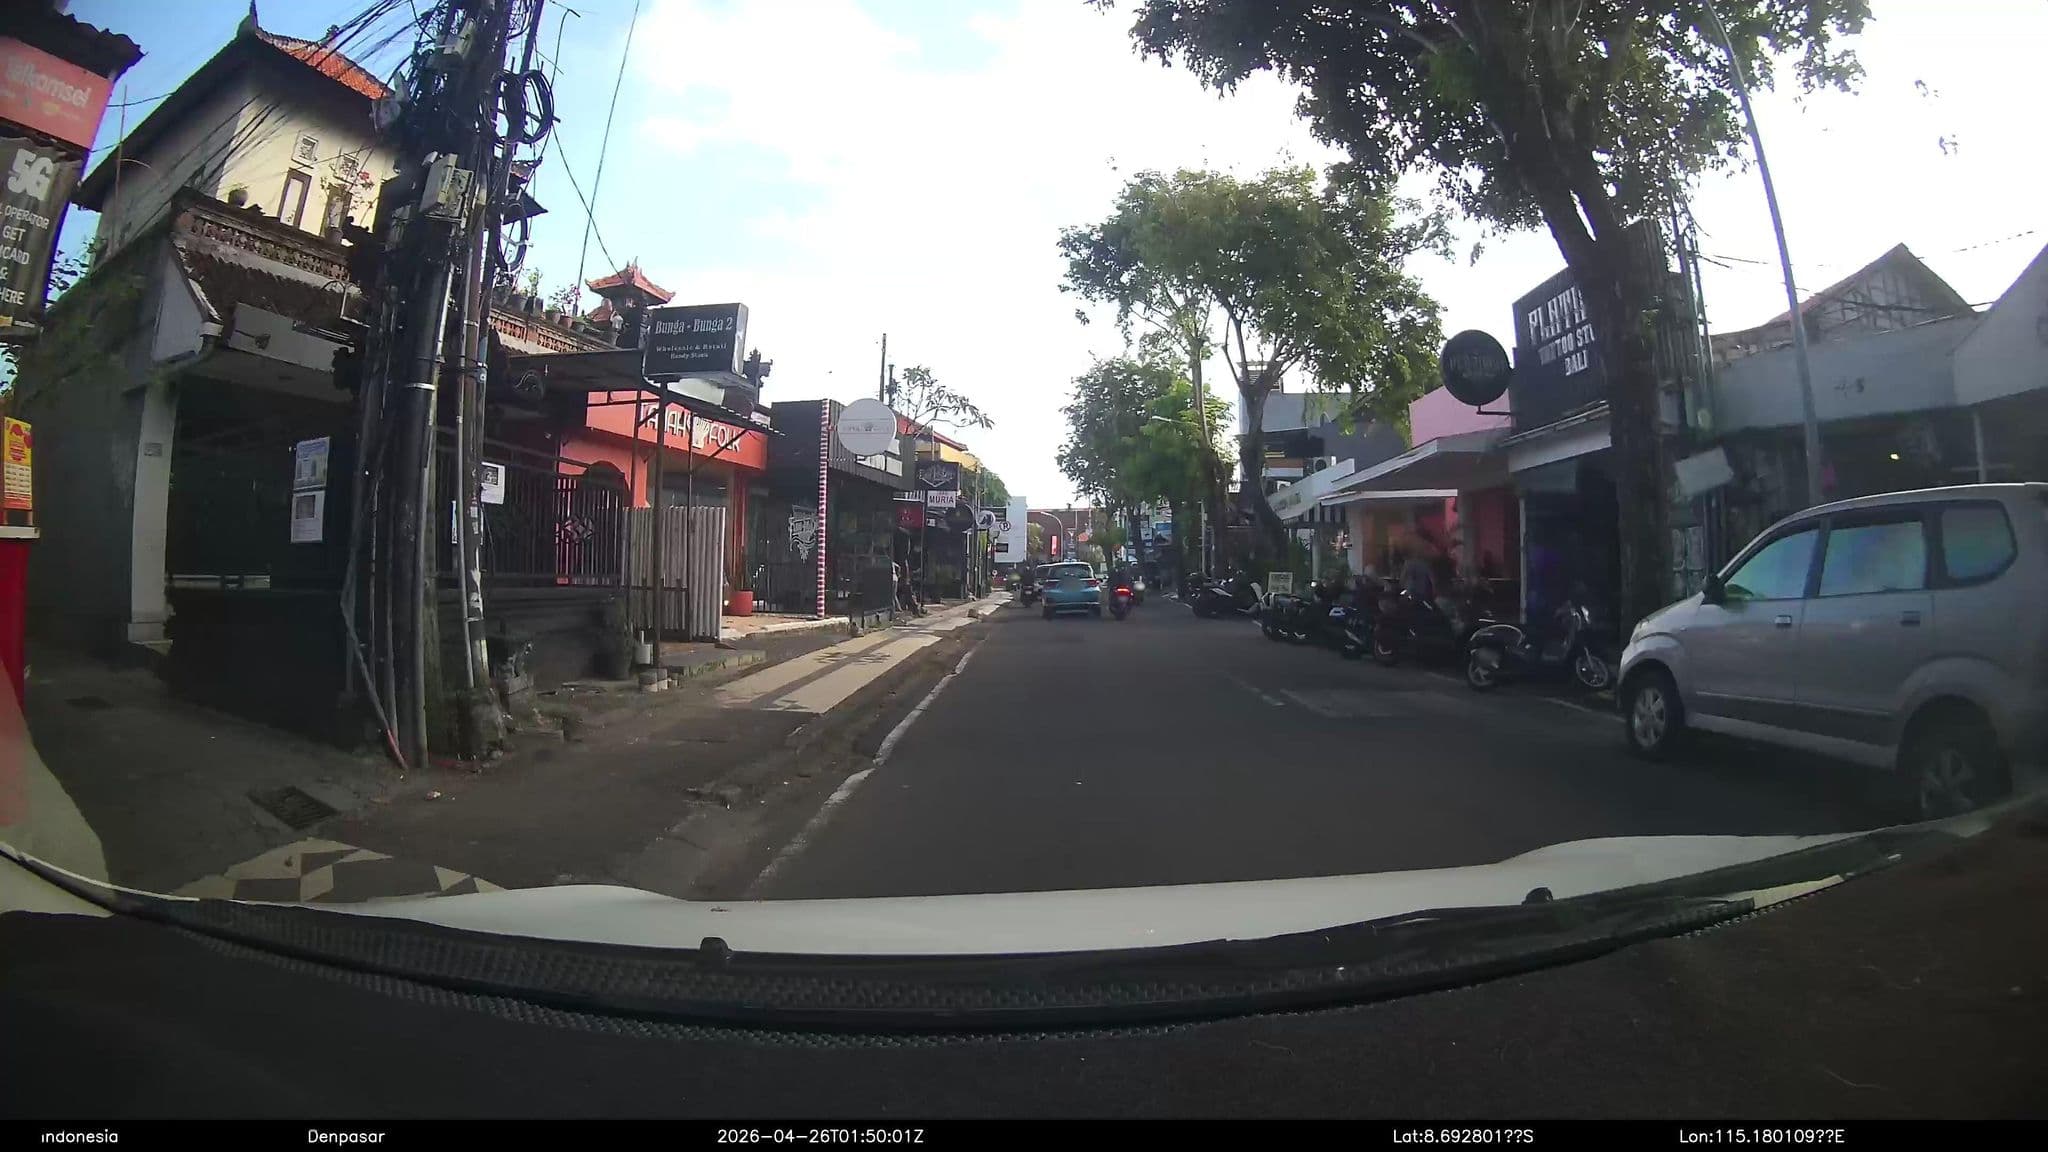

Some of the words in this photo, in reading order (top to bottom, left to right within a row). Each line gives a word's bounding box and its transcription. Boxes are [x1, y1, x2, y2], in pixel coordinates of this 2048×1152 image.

[7, 148, 53, 200] 5G
[5, 205, 49, 229] OPERATOR
[2, 225, 26, 242] GET
[655, 320, 685, 335] Bunga
[692, 317, 723, 333] Bunga
[725, 316, 733, 330] 2
[1565, 350, 1588, 376] BALI
[640, 402, 687, 437] TAAH
[707, 421, 741, 452] FOLK
[929, 495, 955, 505] MURIA
